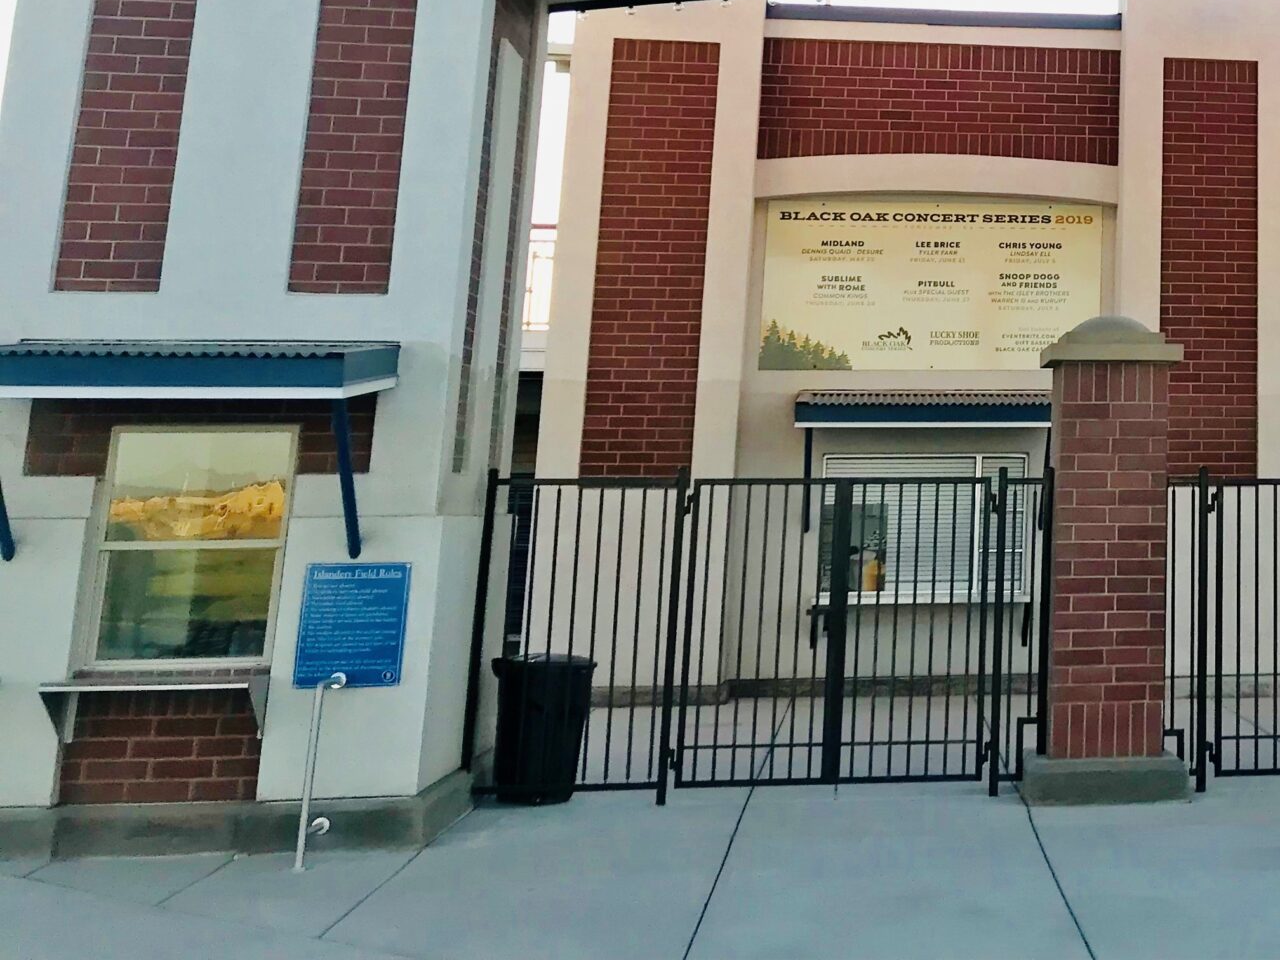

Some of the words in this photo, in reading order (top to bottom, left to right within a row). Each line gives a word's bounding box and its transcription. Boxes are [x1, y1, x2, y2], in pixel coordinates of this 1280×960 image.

[780, 212, 846, 221] BLACK
[850, 212, 890, 222] OAK
[892, 213, 979, 222] CONCERT
[982, 214, 1052, 224] SERIES
[1055, 215, 1094, 224] 2019
[313, 570, 352, 579] Islanders
[355, 568, 377, 578] Field
[380, 569, 402, 578] Rules
